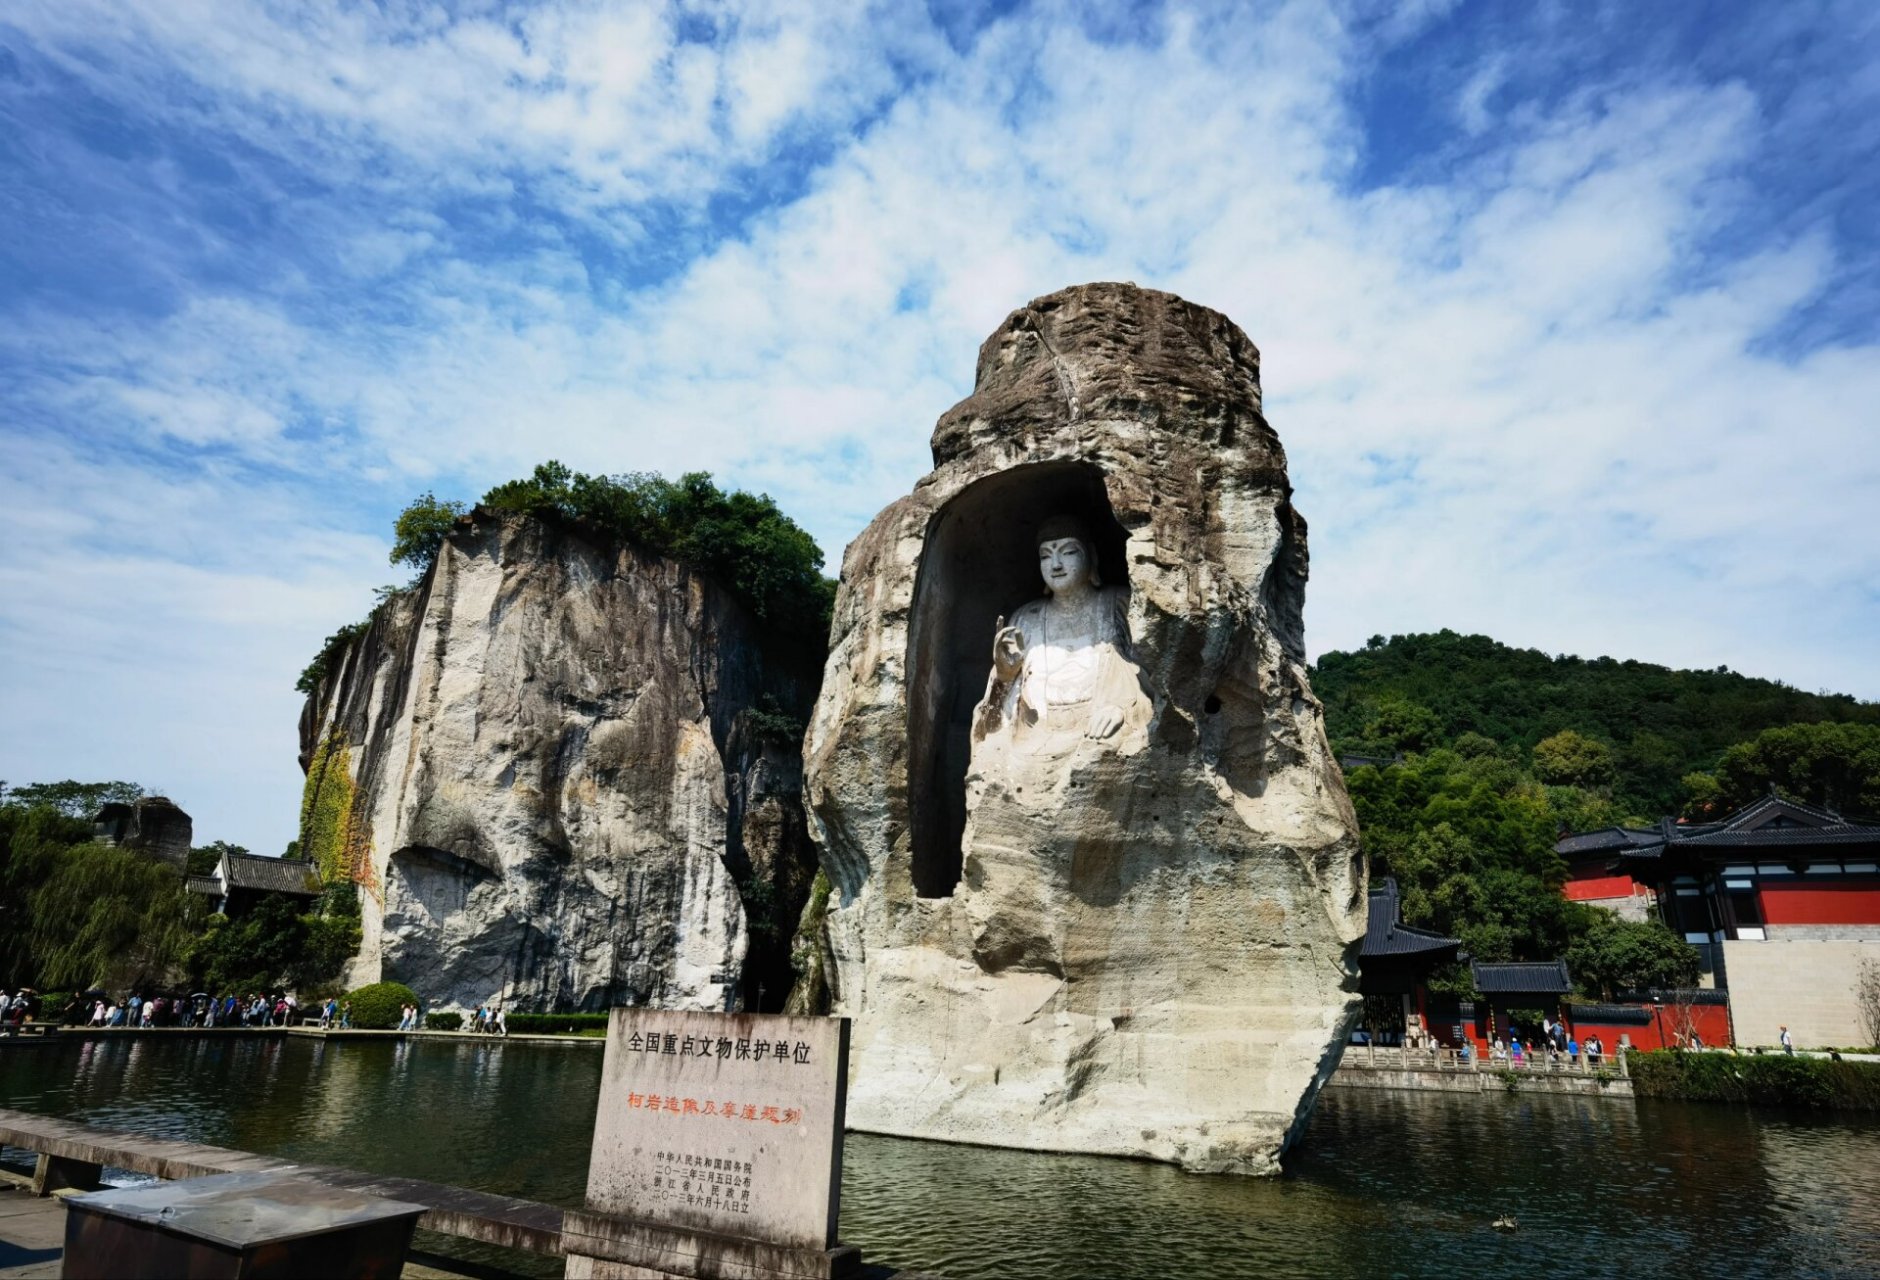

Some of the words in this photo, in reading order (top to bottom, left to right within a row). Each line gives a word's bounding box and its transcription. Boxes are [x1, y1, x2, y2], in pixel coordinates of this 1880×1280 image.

[628, 1031, 811, 1064] 全国重点文物保护单位
[657, 1151, 752, 1174] 中华人民共和国国务院
[653, 1176, 750, 1201] 浙江省人民政府
